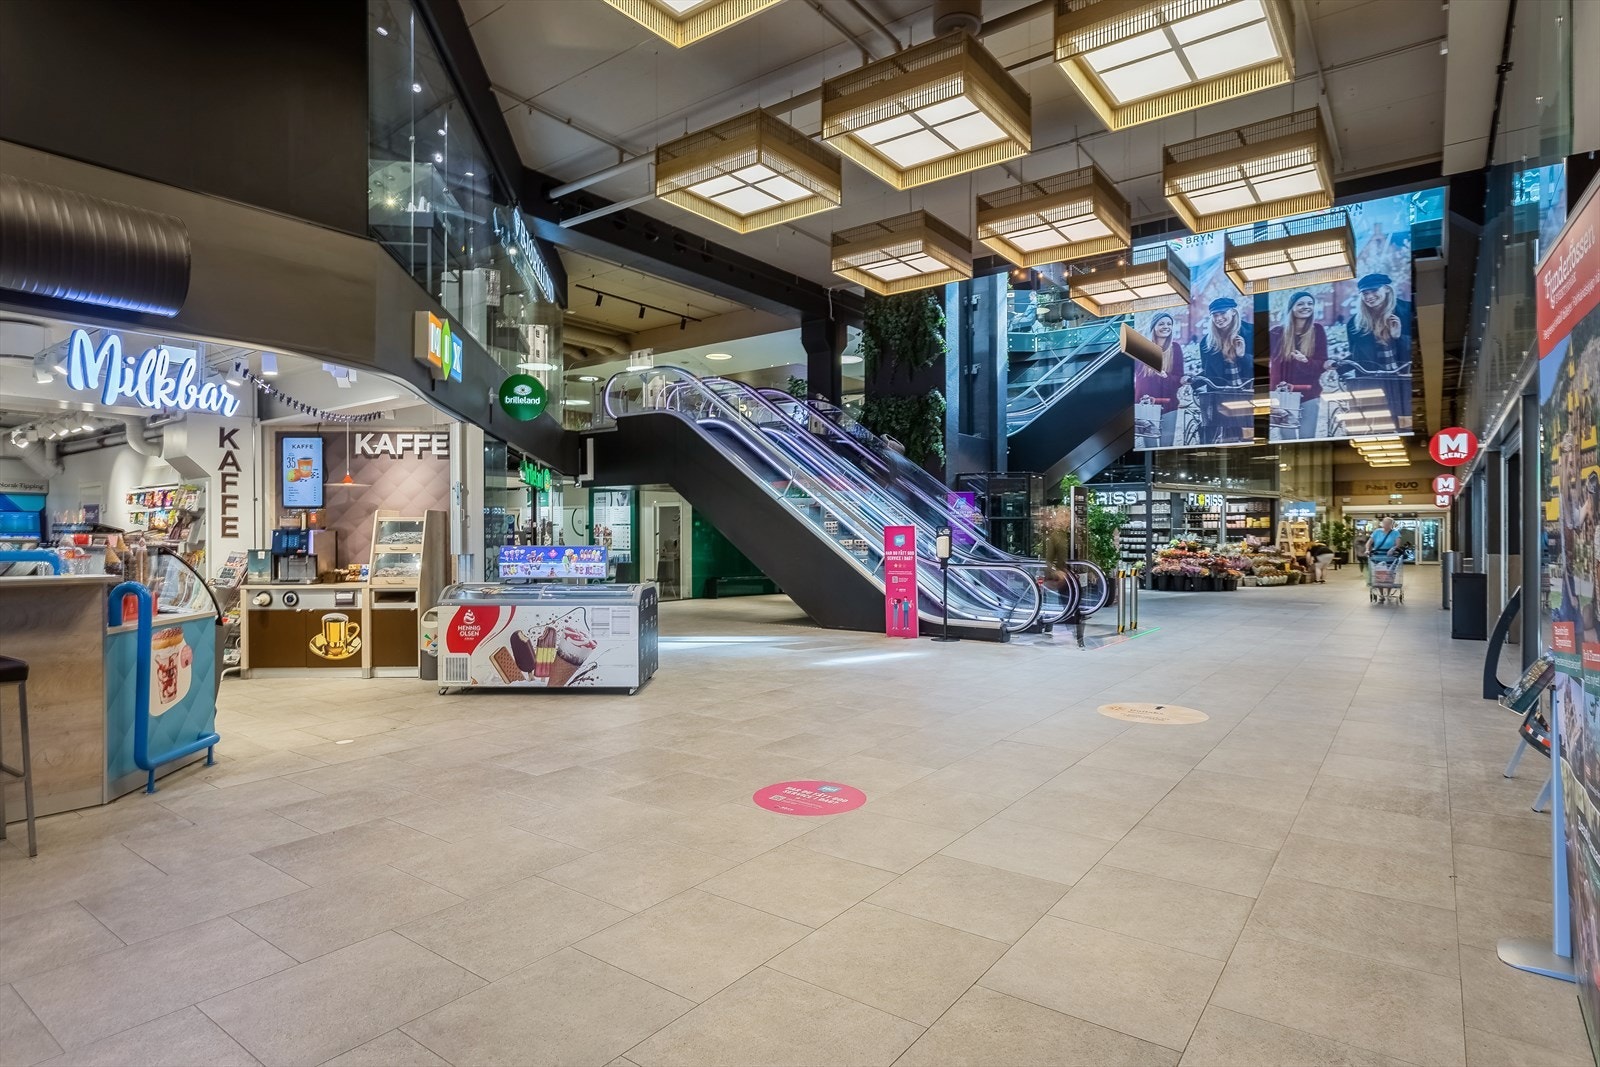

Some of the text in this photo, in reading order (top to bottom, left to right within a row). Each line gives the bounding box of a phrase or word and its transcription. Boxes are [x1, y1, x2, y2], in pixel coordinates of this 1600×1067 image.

[1186, 233, 1214, 245] BRYN
[430, 322, 462, 374] MIX
[67, 329, 240, 418] Milkbar
[505, 395, 541, 405] brilleland
[355, 432, 449, 456] KAFFE
[1440, 451, 1467, 460] MENY
[286, 456, 297, 469] 35
[19, 482, 45, 490] Tipping
[218, 427, 242, 538] KAFFE
[1394, 481, 1419, 489] evo
[1188, 493, 1224, 507] FLORISS
